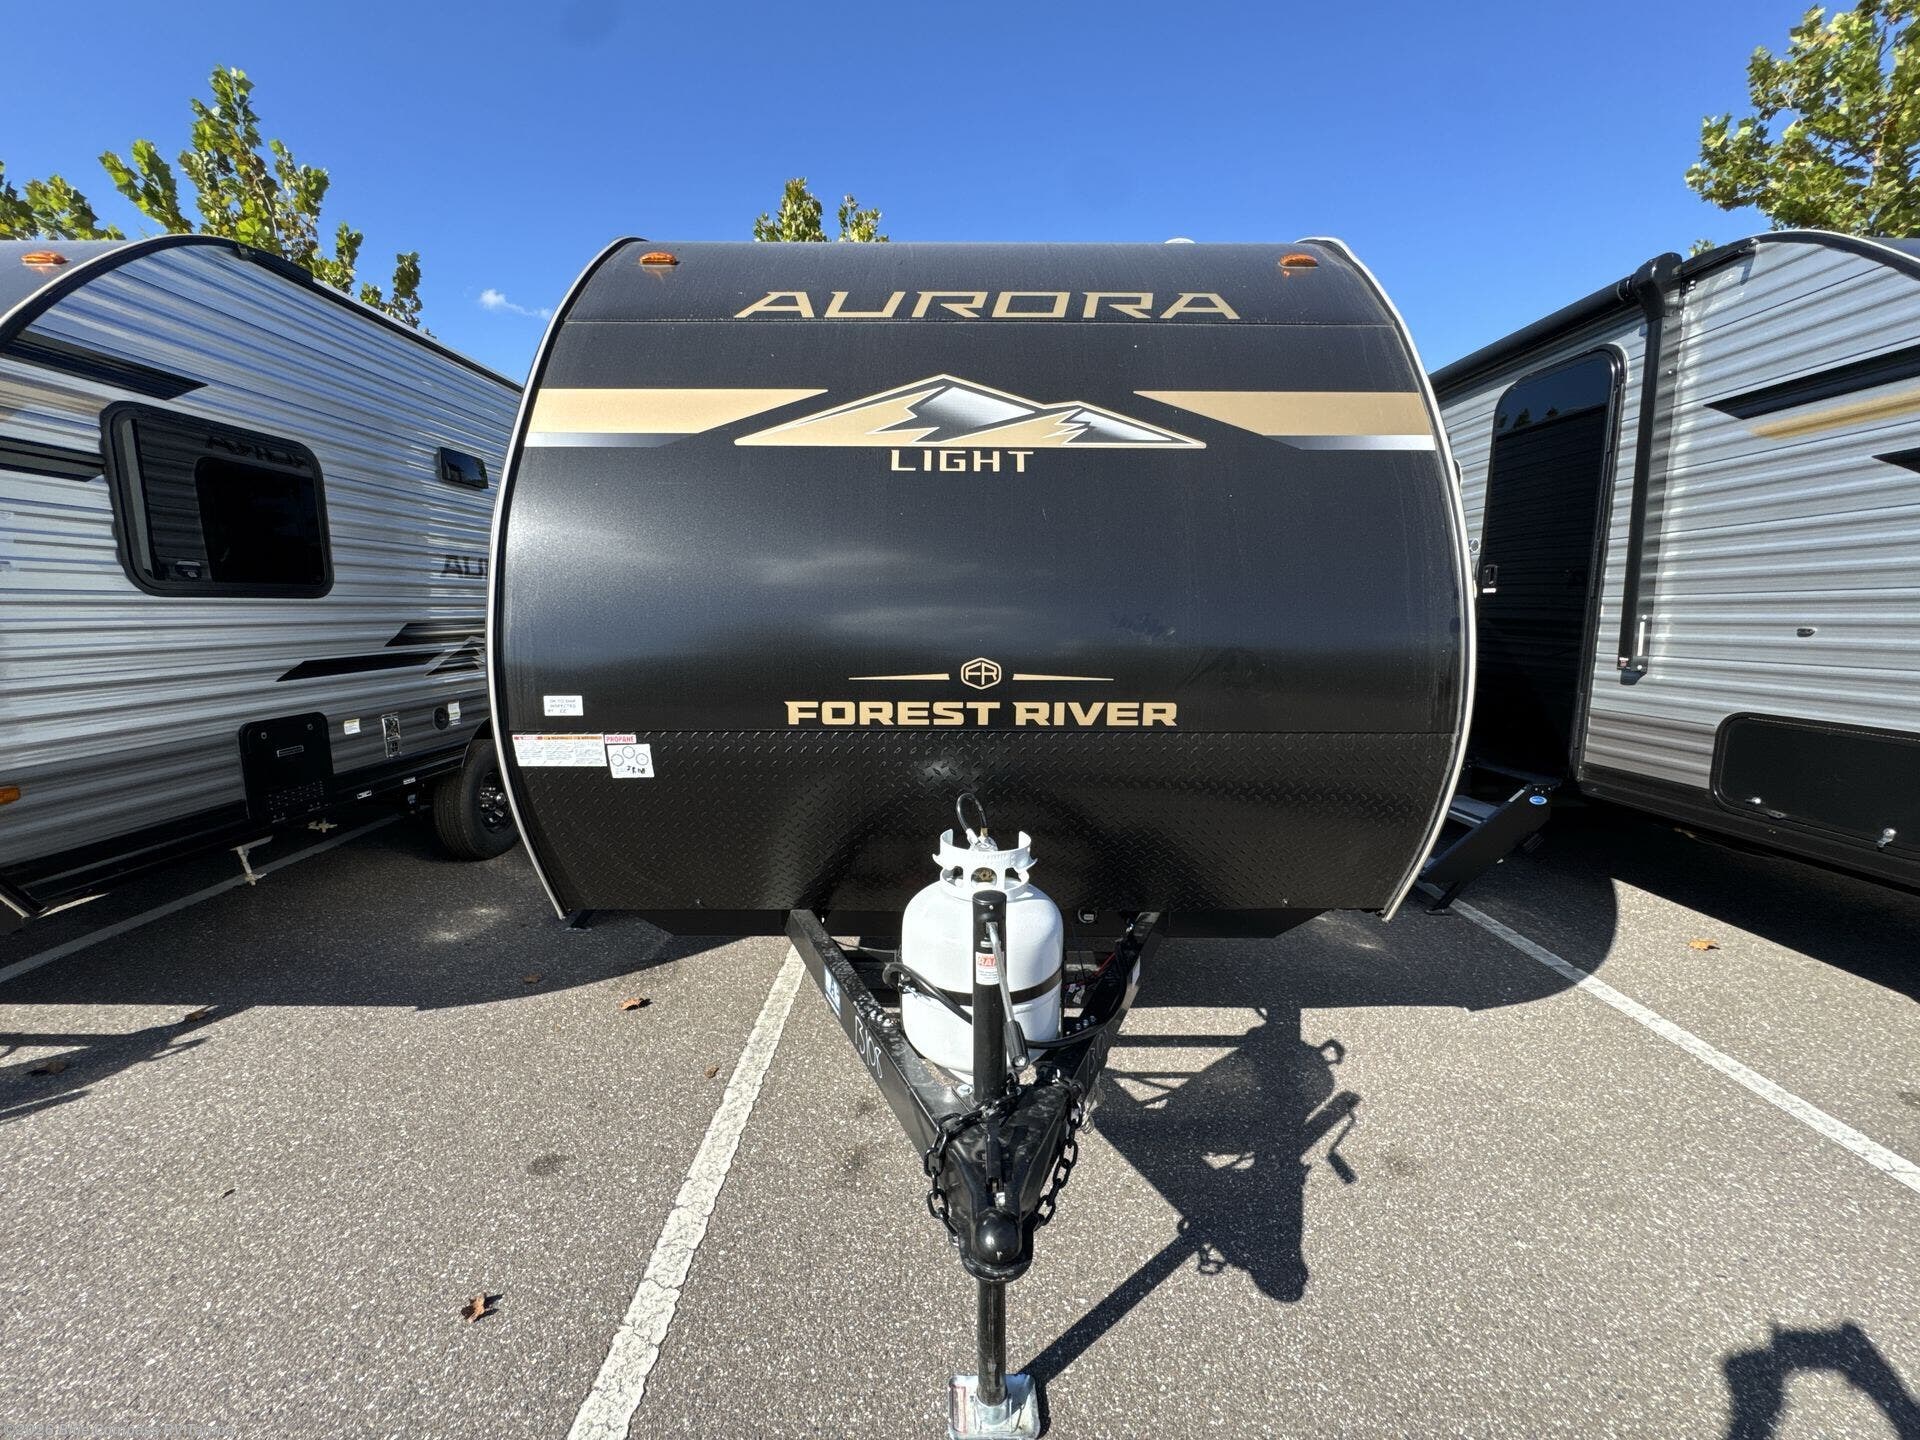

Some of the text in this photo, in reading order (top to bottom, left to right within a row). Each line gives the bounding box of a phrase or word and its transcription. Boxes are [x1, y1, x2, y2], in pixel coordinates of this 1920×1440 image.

[734, 290, 1241, 320] AURORA
[890, 449, 1035, 473] LIGHT
[784, 701, 1178, 727] FOREST RIVER
[606, 735, 634, 743] PROPANE
